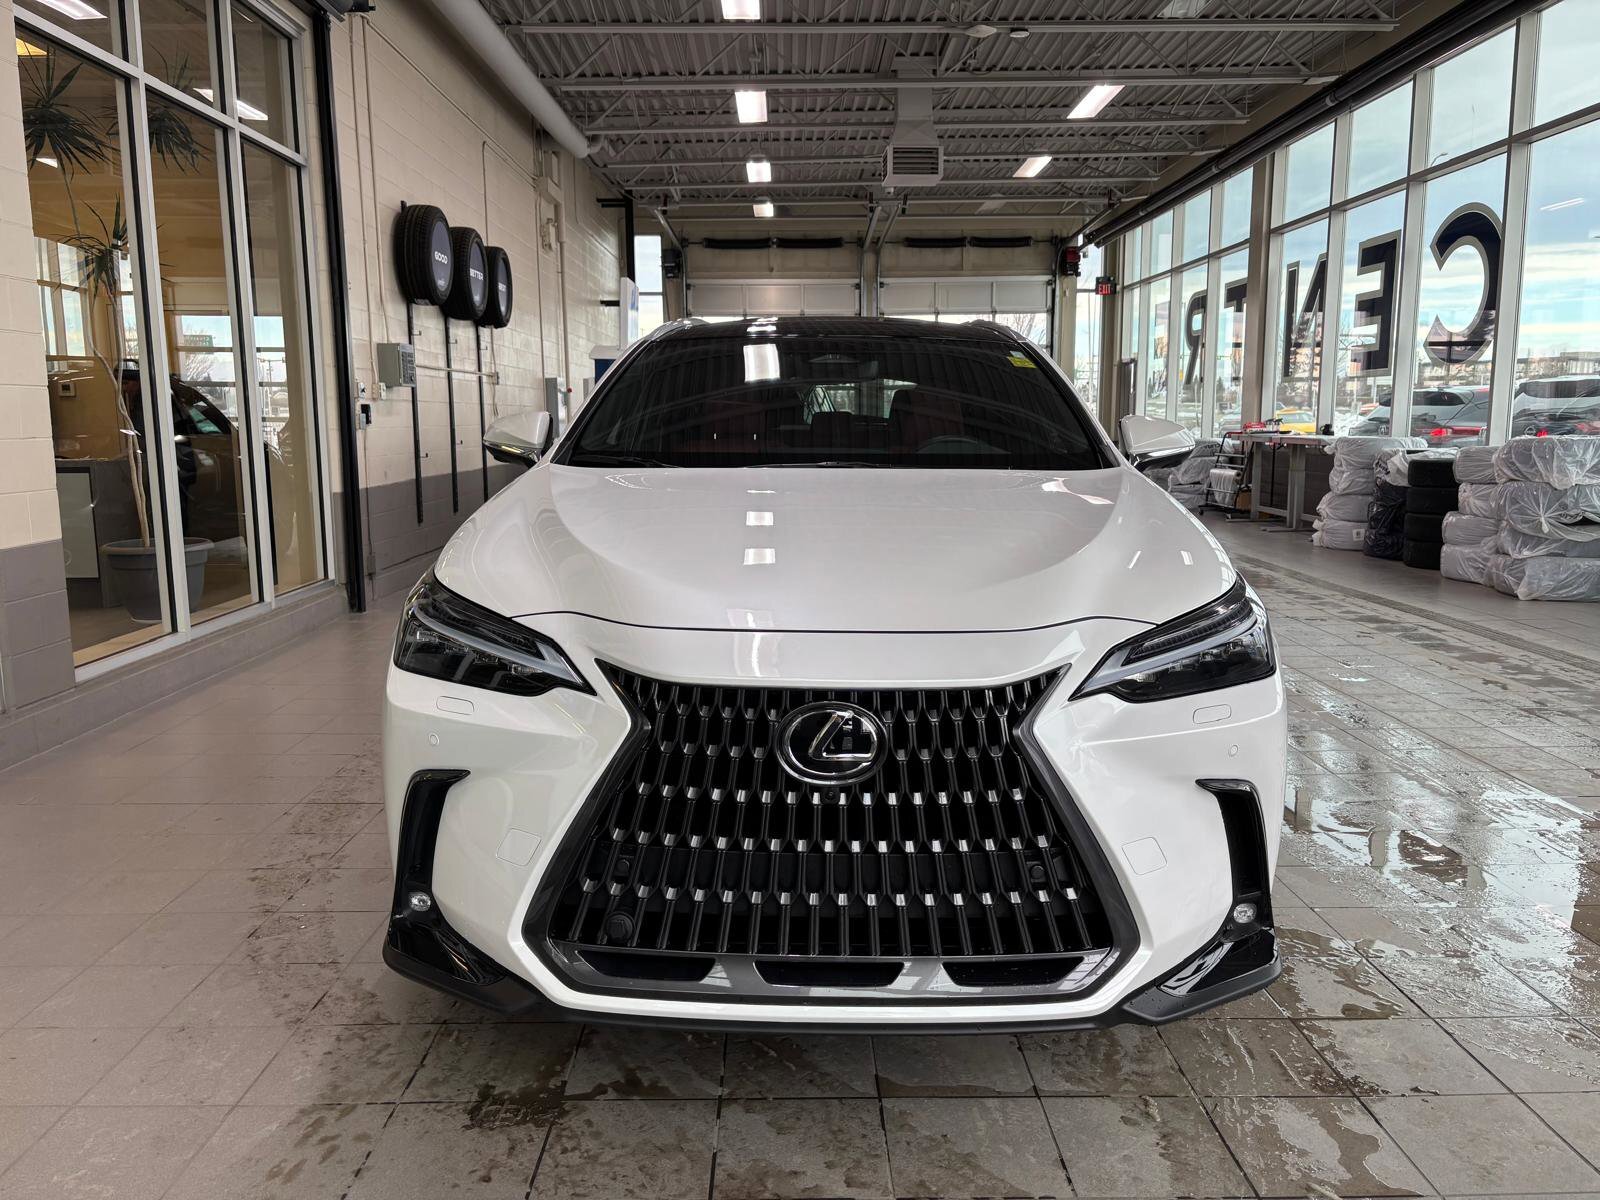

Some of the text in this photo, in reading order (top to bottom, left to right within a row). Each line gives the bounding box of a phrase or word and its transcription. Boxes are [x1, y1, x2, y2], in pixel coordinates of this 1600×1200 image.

[434, 251, 448, 264] GOOD
[469, 267, 484, 281] BETTER
[1098, 283, 1111, 295] EXIT
